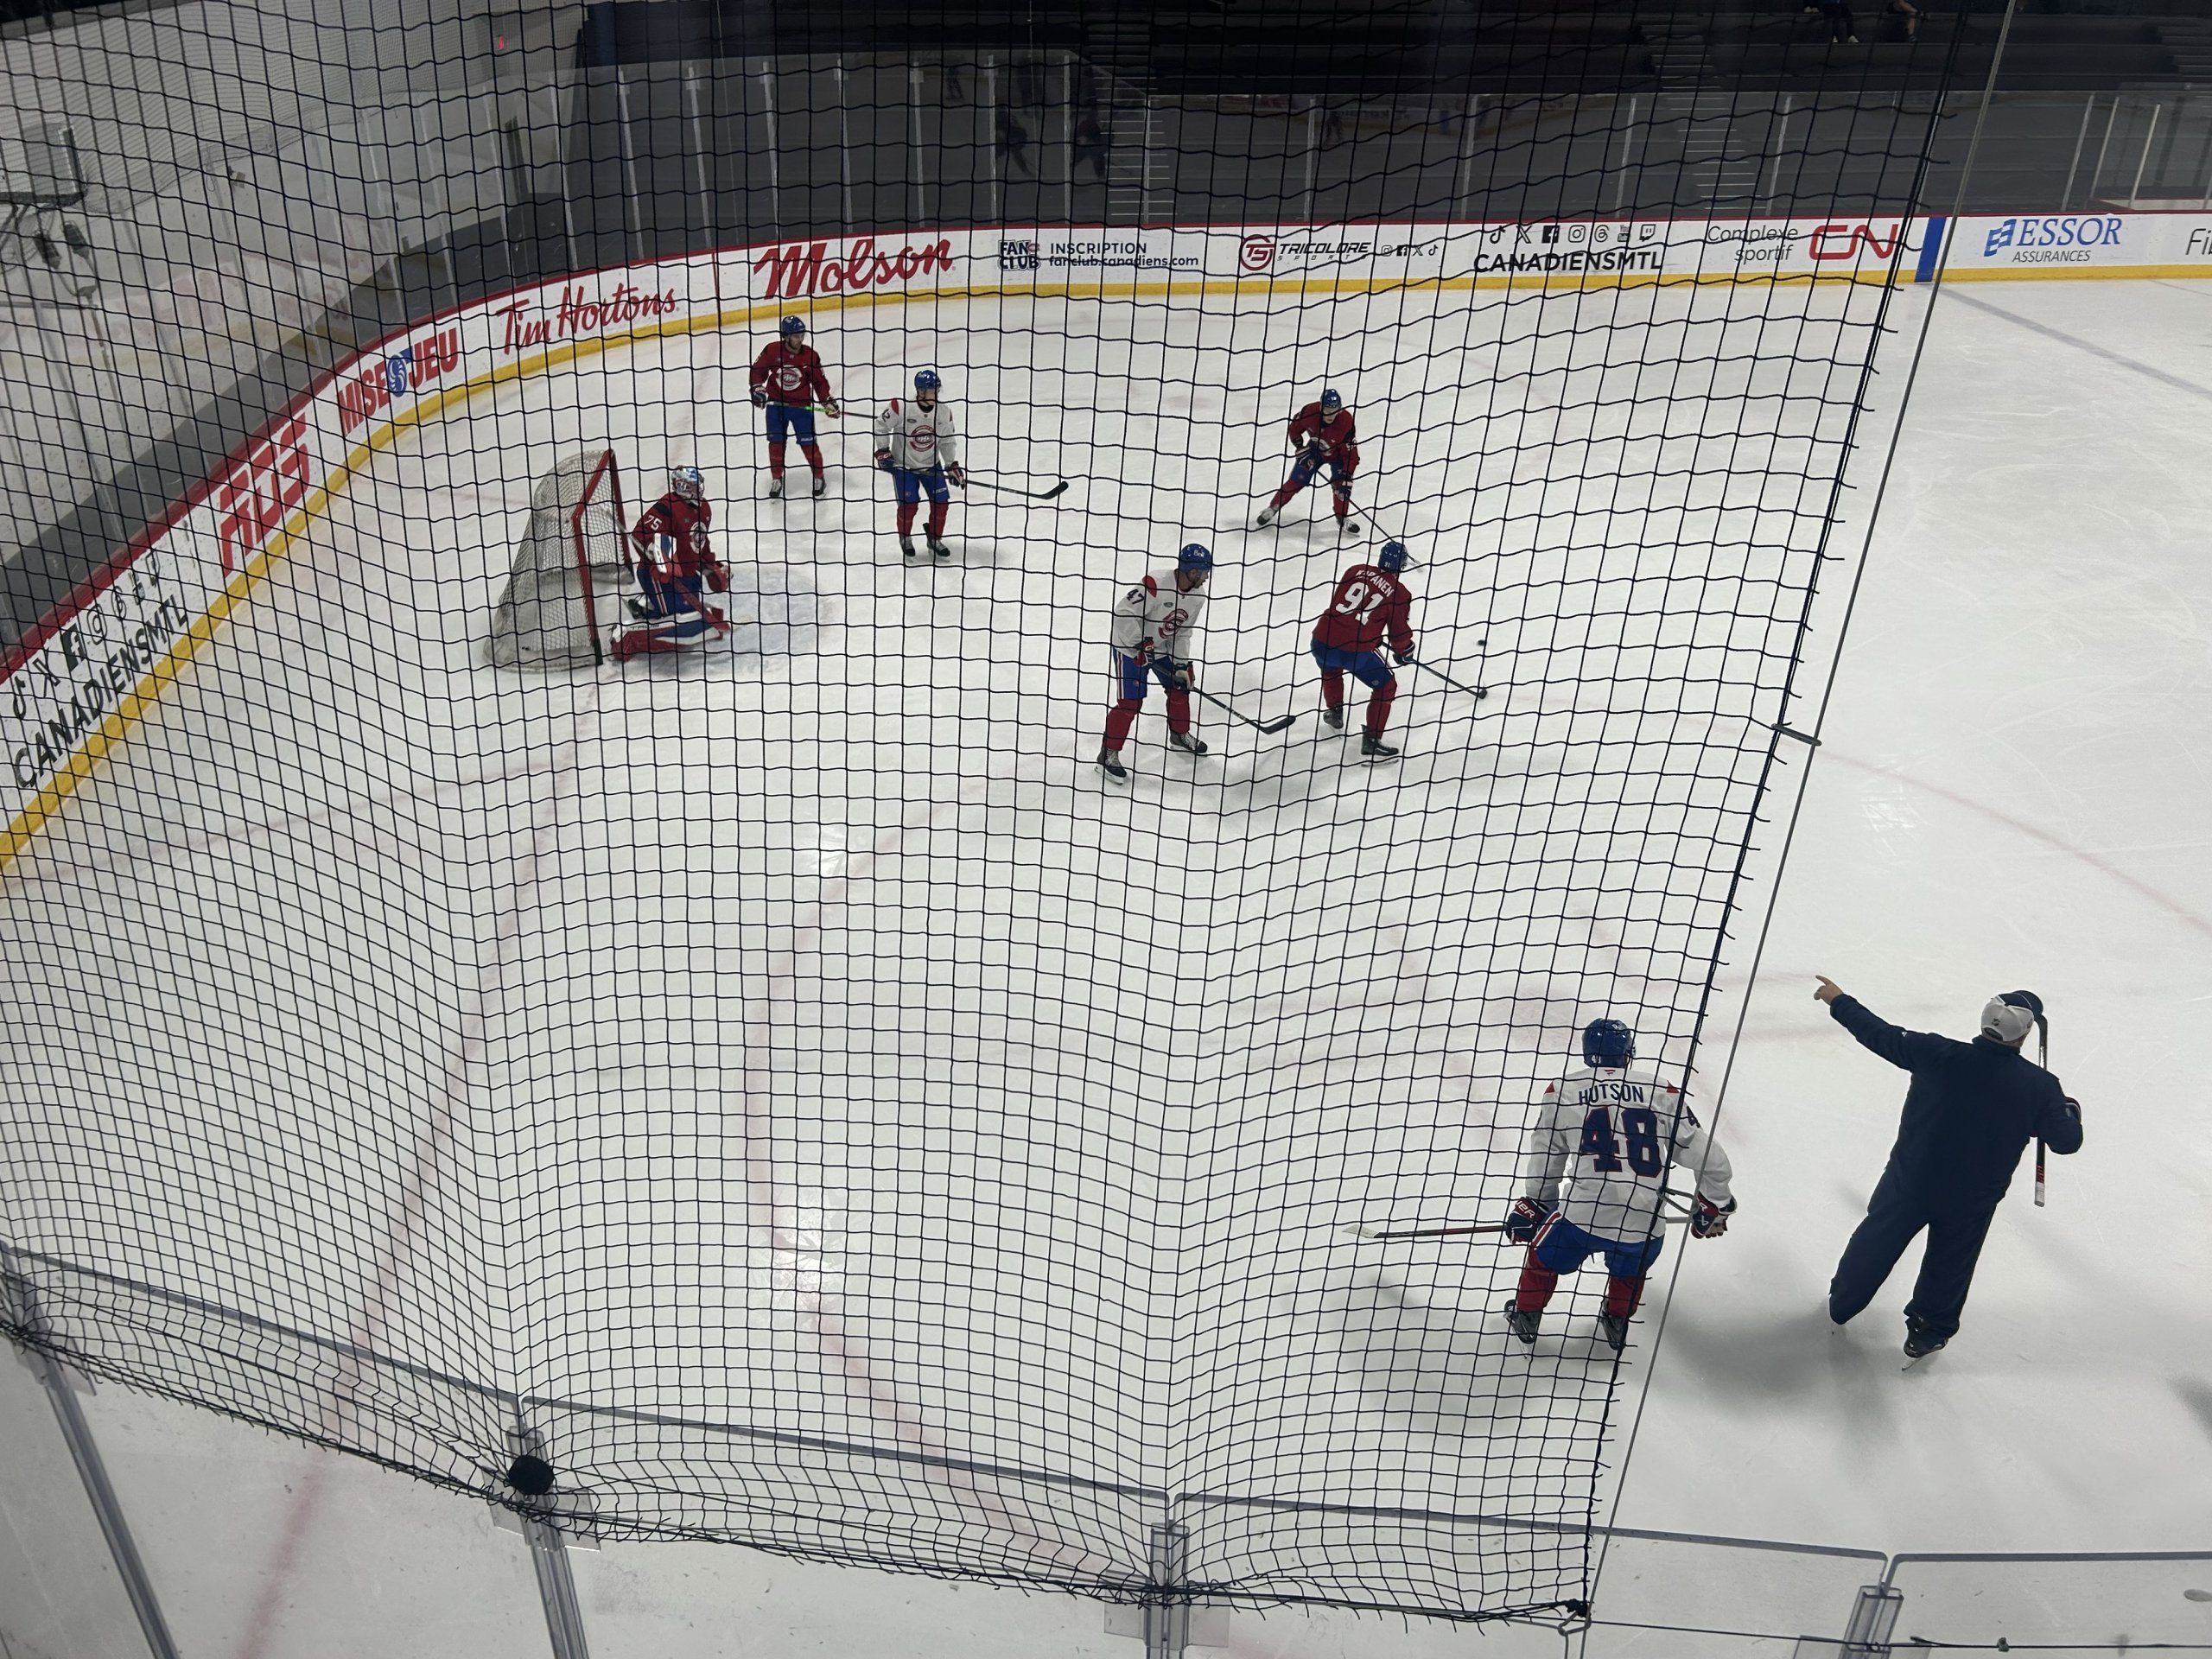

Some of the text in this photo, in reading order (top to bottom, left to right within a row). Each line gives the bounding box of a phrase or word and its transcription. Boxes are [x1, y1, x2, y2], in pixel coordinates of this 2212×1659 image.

[1707, 225, 1798, 245] Complexe
[1808, 224, 1899, 260] CN
[2017, 218, 2122, 246] ESSOR
[1000, 241, 1029, 256] FAN
[1050, 243, 1147, 255] INSCRIPTION
[1280, 242, 1371, 254] TRICOLORE
[1734, 245, 1794, 264] sportif
[2012, 250, 2091, 263] ASSURANCES
[753, 239, 951, 300] Molson
[999, 257, 1039, 270] CLUB
[1049, 256, 1198, 267] fanclub.canadiens.com
[1474, 251, 1662, 272] CANADIENSMTL
[496, 282, 676, 355] Tim Hortons
[337, 327, 459, 437] MISE JEU
[220, 411, 310, 579] RDS
[645, 515, 662, 531] 75
[1127, 588, 1145, 605] 47
[1336, 582, 1383, 626] 91
[14, 594, 188, 788] CANADIENSMTL
[1579, 1083, 1644, 1106] HUTSON
[1580, 1105, 1662, 1178] 48
